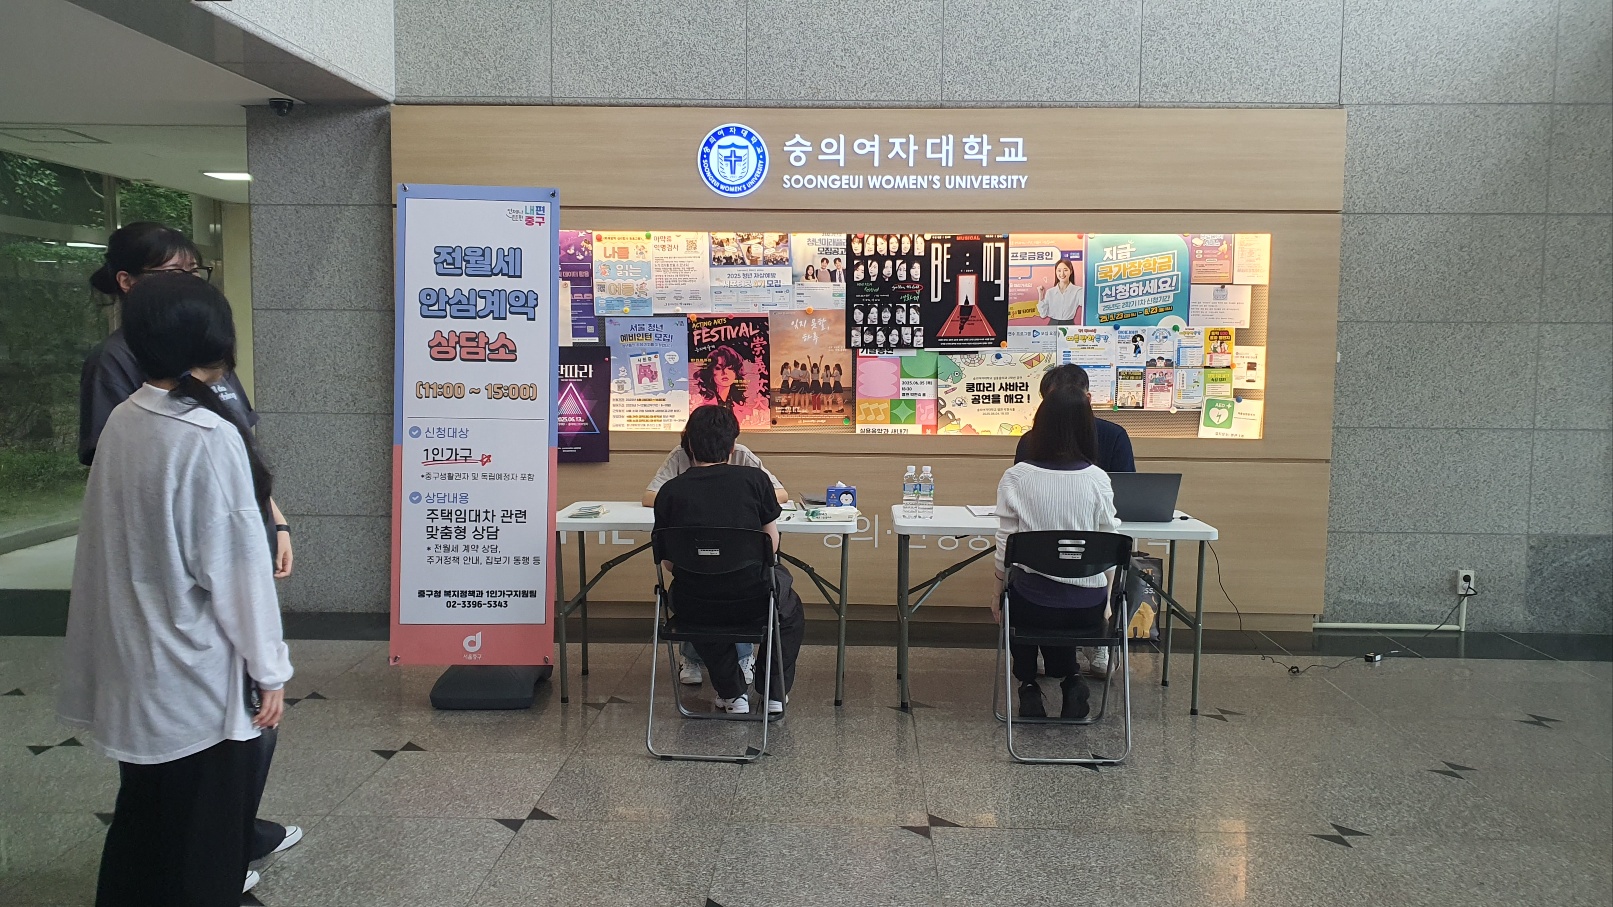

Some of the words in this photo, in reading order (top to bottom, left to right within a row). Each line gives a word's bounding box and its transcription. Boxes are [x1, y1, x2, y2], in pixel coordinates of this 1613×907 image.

[783, 133, 1028, 168] 숭의여자대학교
[783, 174, 864, 189] SOONGEUI
[867, 174, 941, 189] WOMEN'S
[945, 174, 1028, 189] UNIVERSITY
[524, 205, 546, 216] 내편
[524, 215, 546, 227] 중구
[603, 246, 630, 259] 나를
[817, 246, 847, 256] 모집공고
[1010, 250, 1054, 261] 프로금융인
[1102, 242, 1136, 262] 지금
[433, 245, 523, 279] 전월세
[1097, 253, 1174, 282] 국가장학금
[615, 263, 642, 278] 읽는
[742, 272, 753, 280] 청년
[607, 281, 635, 297] 여름
[1101, 275, 1177, 302] 신청하세요!
[418, 287, 539, 321] 안심계약
[1102, 303, 1121, 312] 25년도
[1121, 300, 1137, 309] 2학기
[1146, 294, 1171, 305] 신청기간
[629, 323, 646, 332] 서울
[647, 323, 664, 333] 청년
[692, 320, 712, 329] ACTING
[713, 317, 727, 326] ARTS
[620, 332, 653, 342] 예비인턴
[654, 333, 673, 343] 모집!
[693, 321, 760, 346] FESTIVAL
[428, 329, 518, 363] 상담소
[415, 381, 466, 400] (11:00
[485, 383, 538, 401] 15:00)
[965, 381, 996, 393] 쿵따리
[997, 381, 1030, 392] 샤바라
[971, 393, 1001, 405] 공연을
[1003, 393, 1024, 404] 해요
[424, 426, 470, 439] 신청대상
[422, 447, 473, 463] 1인가구
[471, 472, 479, 481] 및
[480, 472, 518, 481] 독립예정자
[519, 473, 535, 482] 포함
[424, 492, 470, 505] 상담내용
[425, 508, 497, 524] 주택임대차
[500, 509, 528, 524] 관련
[425, 525, 467, 540] 맞춤형
[471, 526, 500, 540] 상담
[433, 544, 459, 554] 전월세
[461, 544, 480, 554] 계약
[481, 544, 501, 555] 상담,
[426, 555, 460, 566] 주거정책
[462, 555, 483, 567] 안내,
[485, 555, 511, 566] 집보기
[513, 556, 530, 566] 동행
[532, 556, 541, 566] 등
[417, 589, 442, 598] 중구청
[443, 589, 484, 598] 복지정책과
[485, 589, 537, 599] 1인가구지원팀
[445, 600, 509, 609] 02-3396-5343
